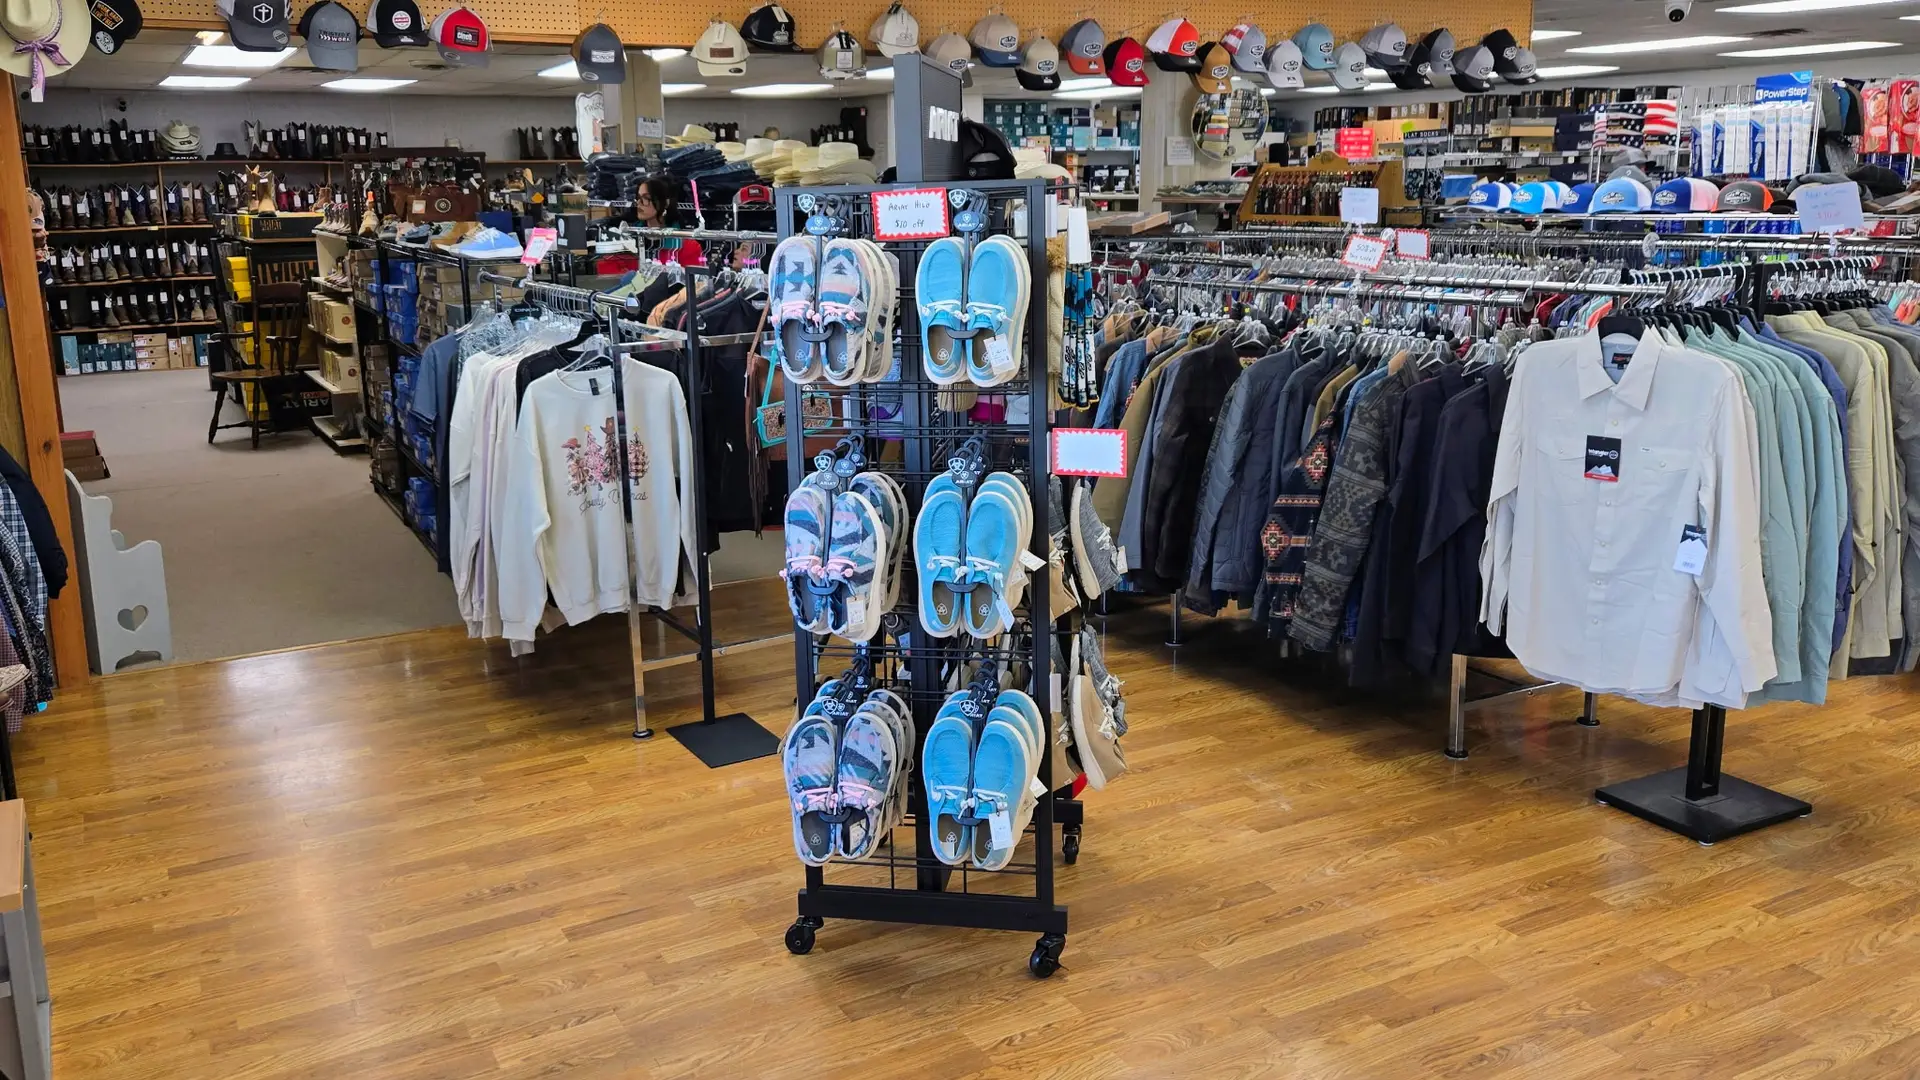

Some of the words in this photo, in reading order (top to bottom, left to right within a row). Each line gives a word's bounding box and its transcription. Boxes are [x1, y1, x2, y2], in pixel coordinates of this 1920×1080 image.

[456, 31, 473, 41] cinch
[1763, 87, 1808, 99] PowerStep
[928, 105, 960, 142] ARIAT
[895, 219, 908, 229] $10
[912, 219, 925, 228] off
